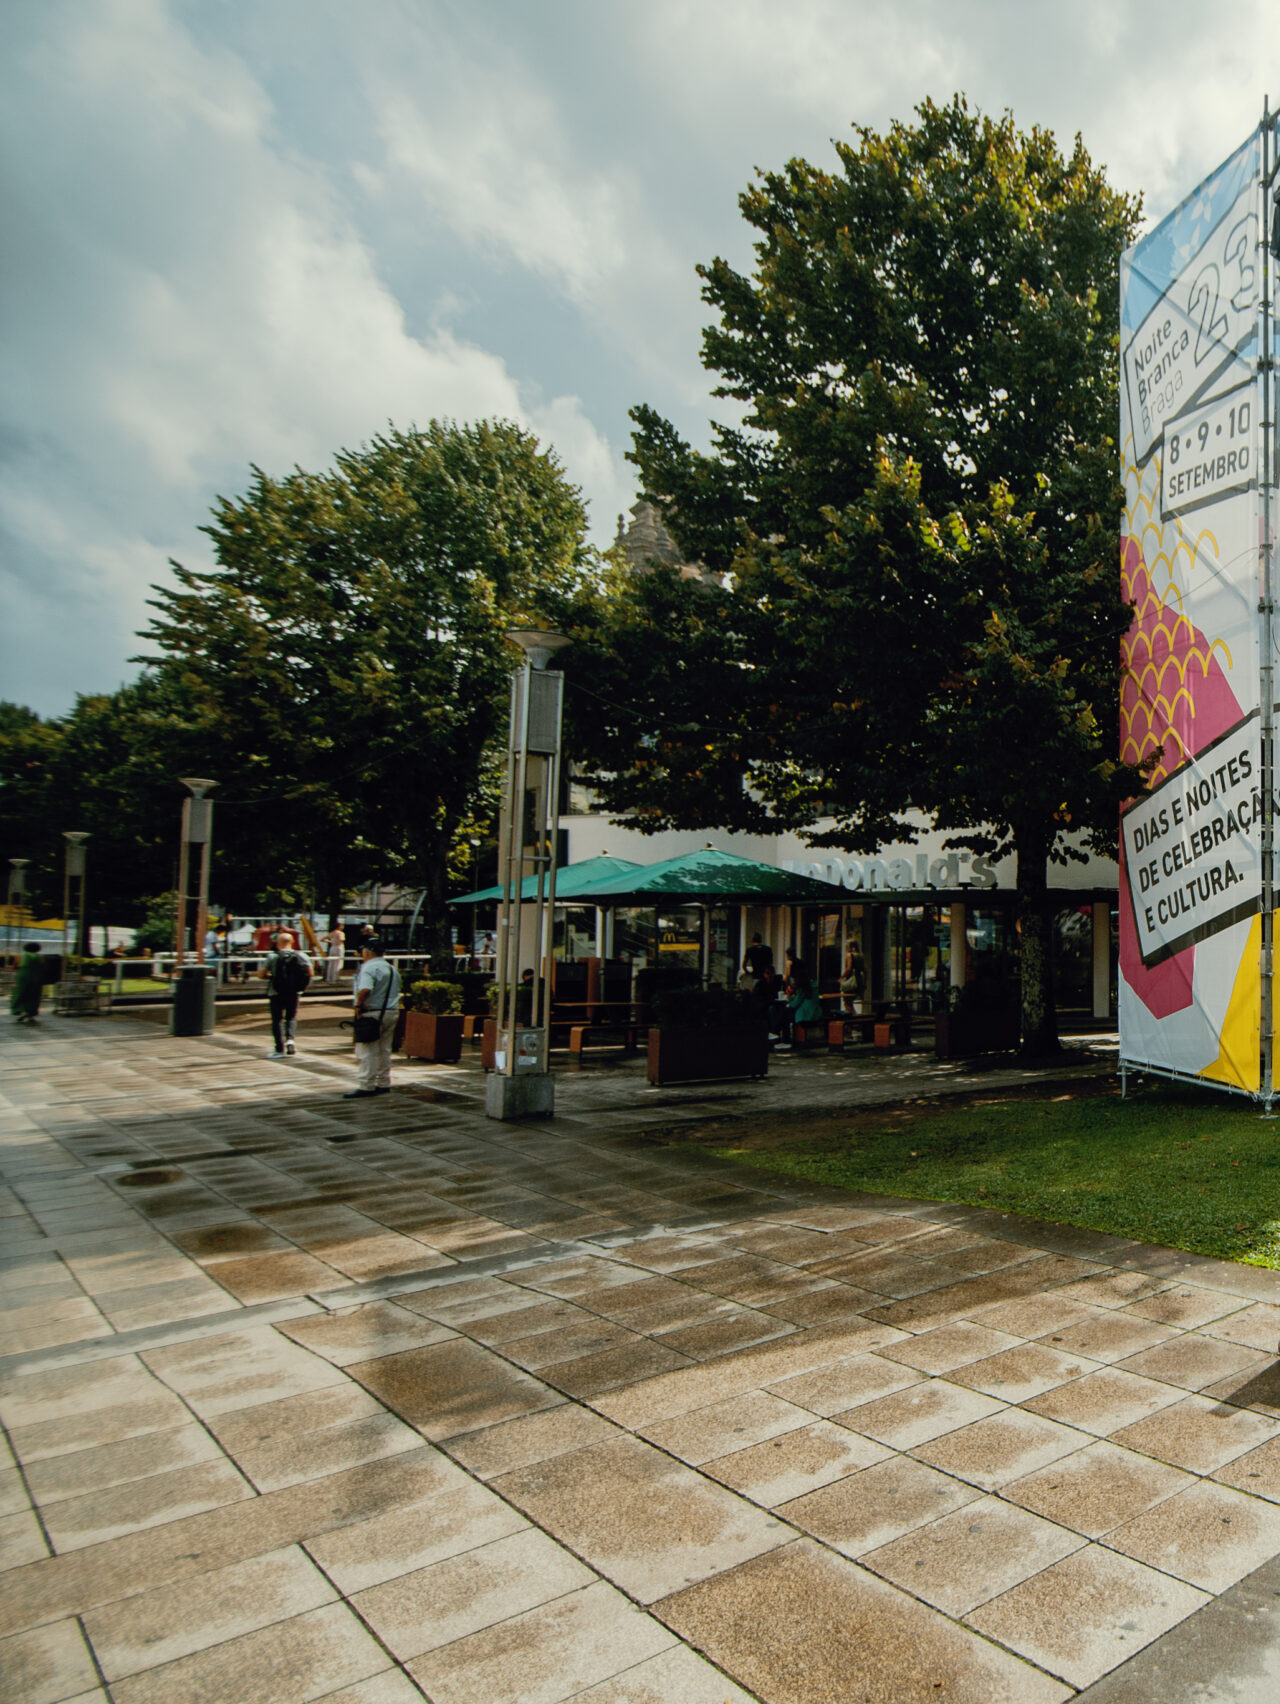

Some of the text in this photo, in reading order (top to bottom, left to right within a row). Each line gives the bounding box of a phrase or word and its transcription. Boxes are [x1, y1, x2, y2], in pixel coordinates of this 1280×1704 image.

[1188, 212, 1259, 367] 23
[1134, 319, 1172, 380] Noite
[1138, 329, 1190, 407] Branca
[1141, 369, 1184, 436] Braga
[1229, 402, 1251, 440] 10
[1168, 446, 1250, 499] SETEMBRO
[1132, 749, 1253, 854] DIAS E NOITES
[1138, 858, 1160, 893] DE
[1144, 859, 1245, 934] E CULTURA.
